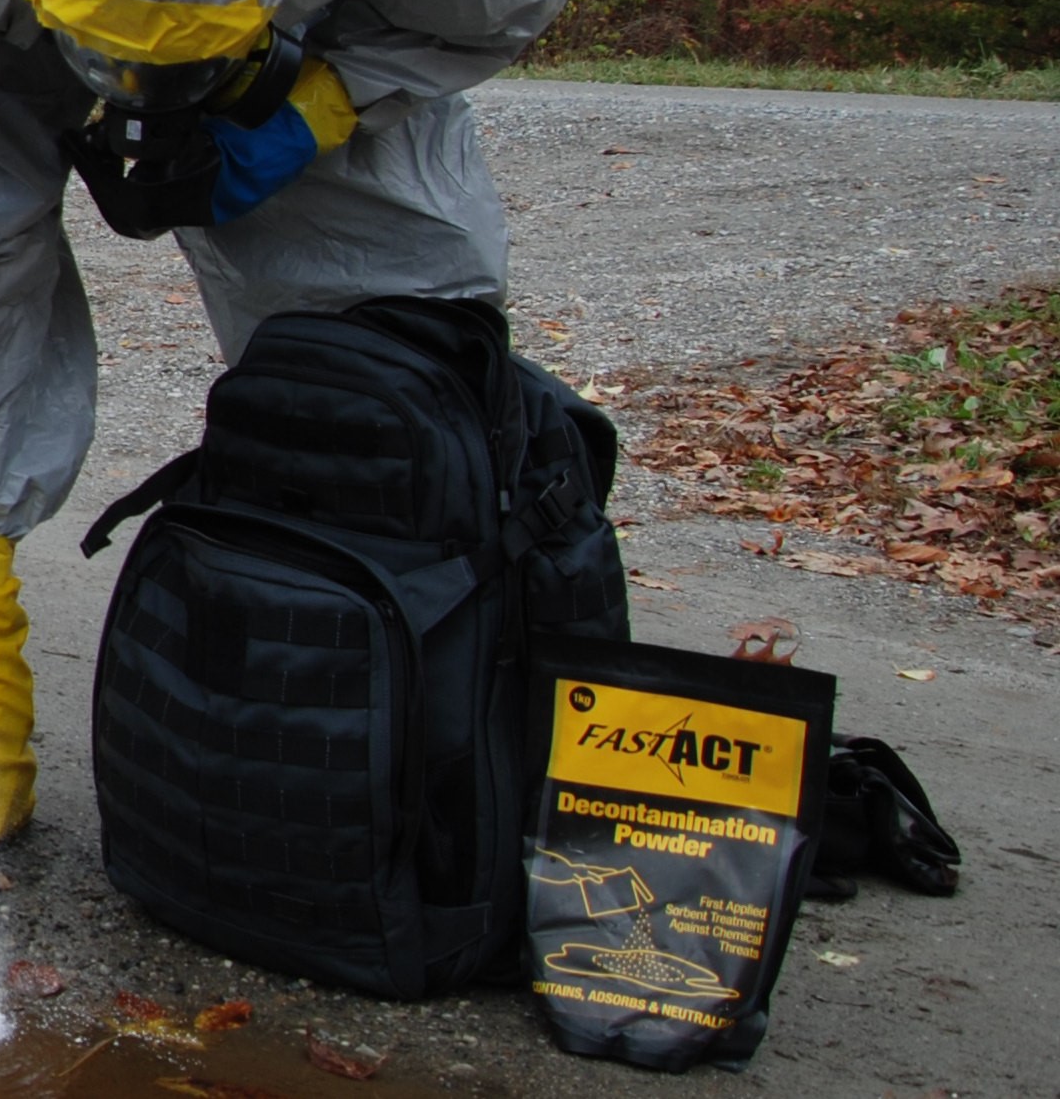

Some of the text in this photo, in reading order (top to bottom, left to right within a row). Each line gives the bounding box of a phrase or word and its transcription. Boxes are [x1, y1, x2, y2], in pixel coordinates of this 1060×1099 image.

[573, 692, 592, 708] 1kg
[557, 790, 777, 846] Decontamination
[614, 822, 713, 859] Powder
[665, 903, 765, 933] Sorbent Treatment
[700, 895, 768, 919] First Applied
[669, 917, 763, 946] Against Chemical
[720, 941, 760, 960] Threats
[648, 1000, 660, 1015] &
